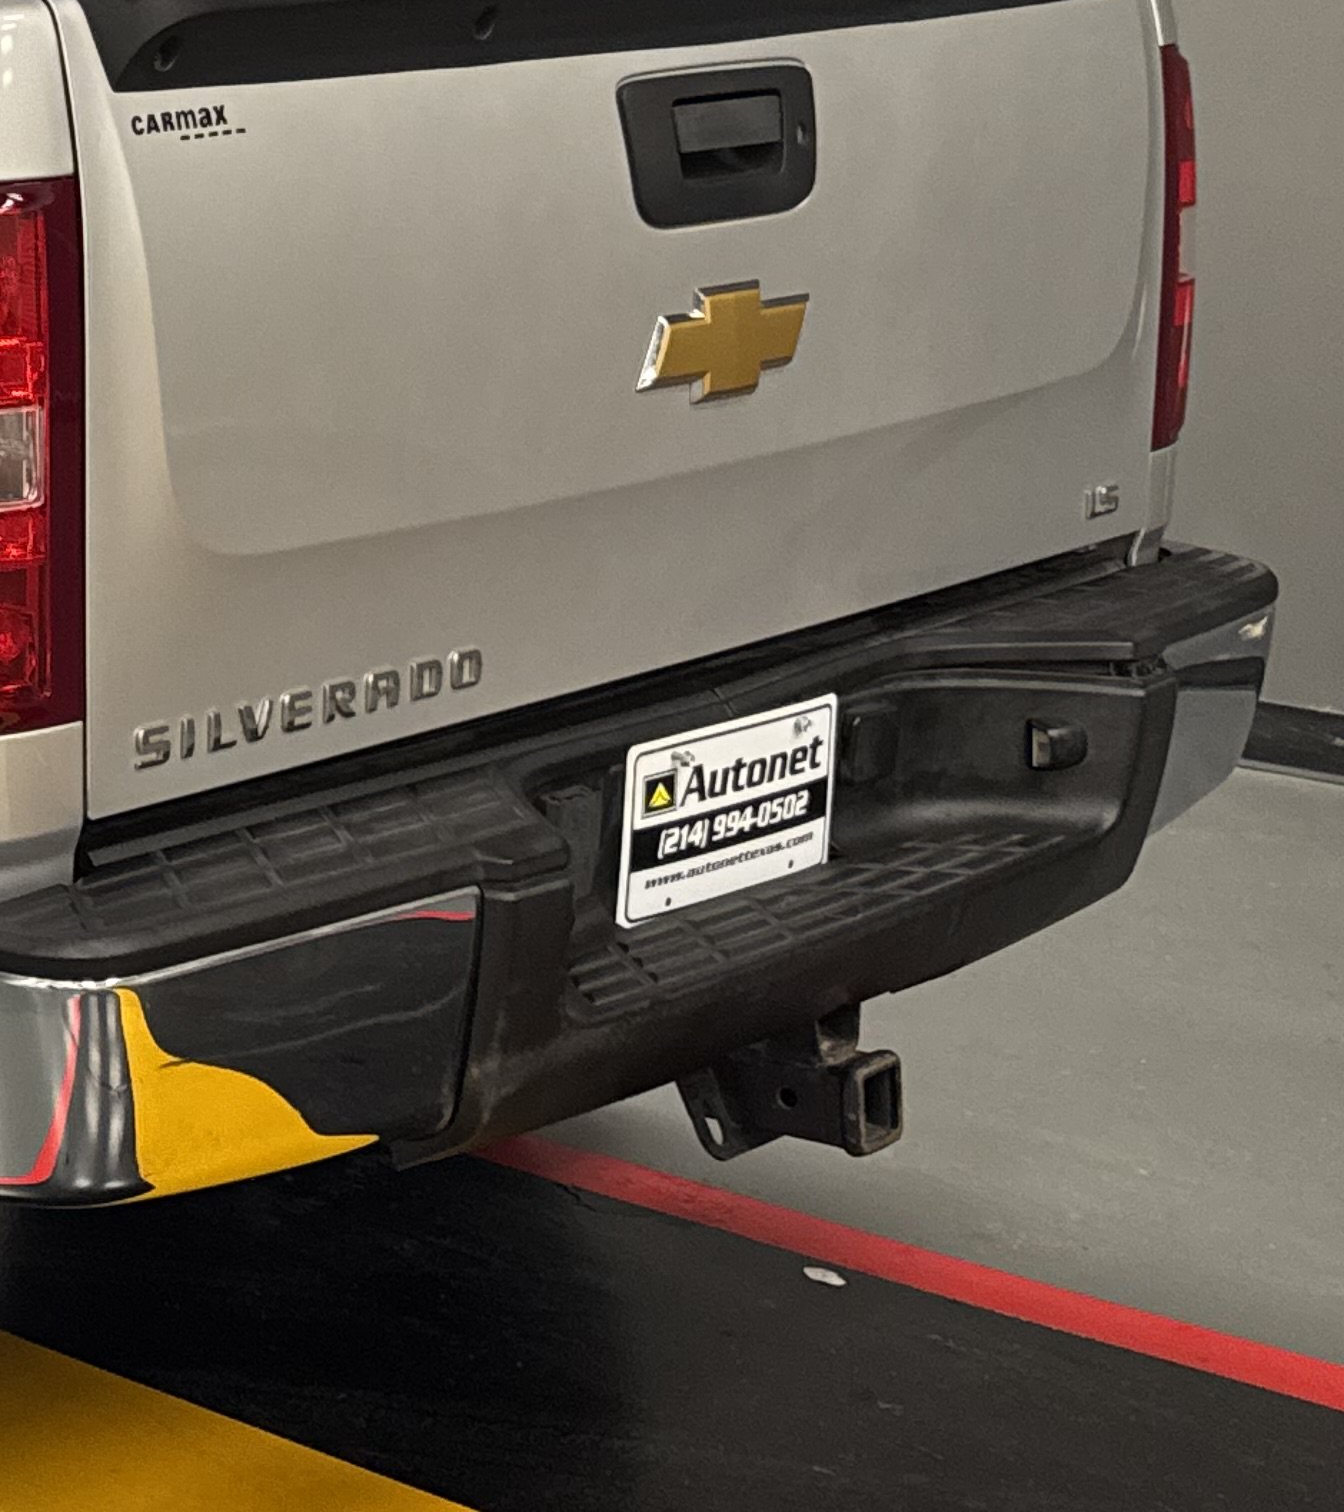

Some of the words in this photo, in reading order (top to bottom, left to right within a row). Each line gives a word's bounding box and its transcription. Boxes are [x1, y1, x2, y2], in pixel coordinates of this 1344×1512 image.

[133, 645, 483, 771] SILVERADO
[681, 736, 823, 807] Autonet
[657, 820, 708, 860] (214)
[713, 789, 810, 842] 994-0502
